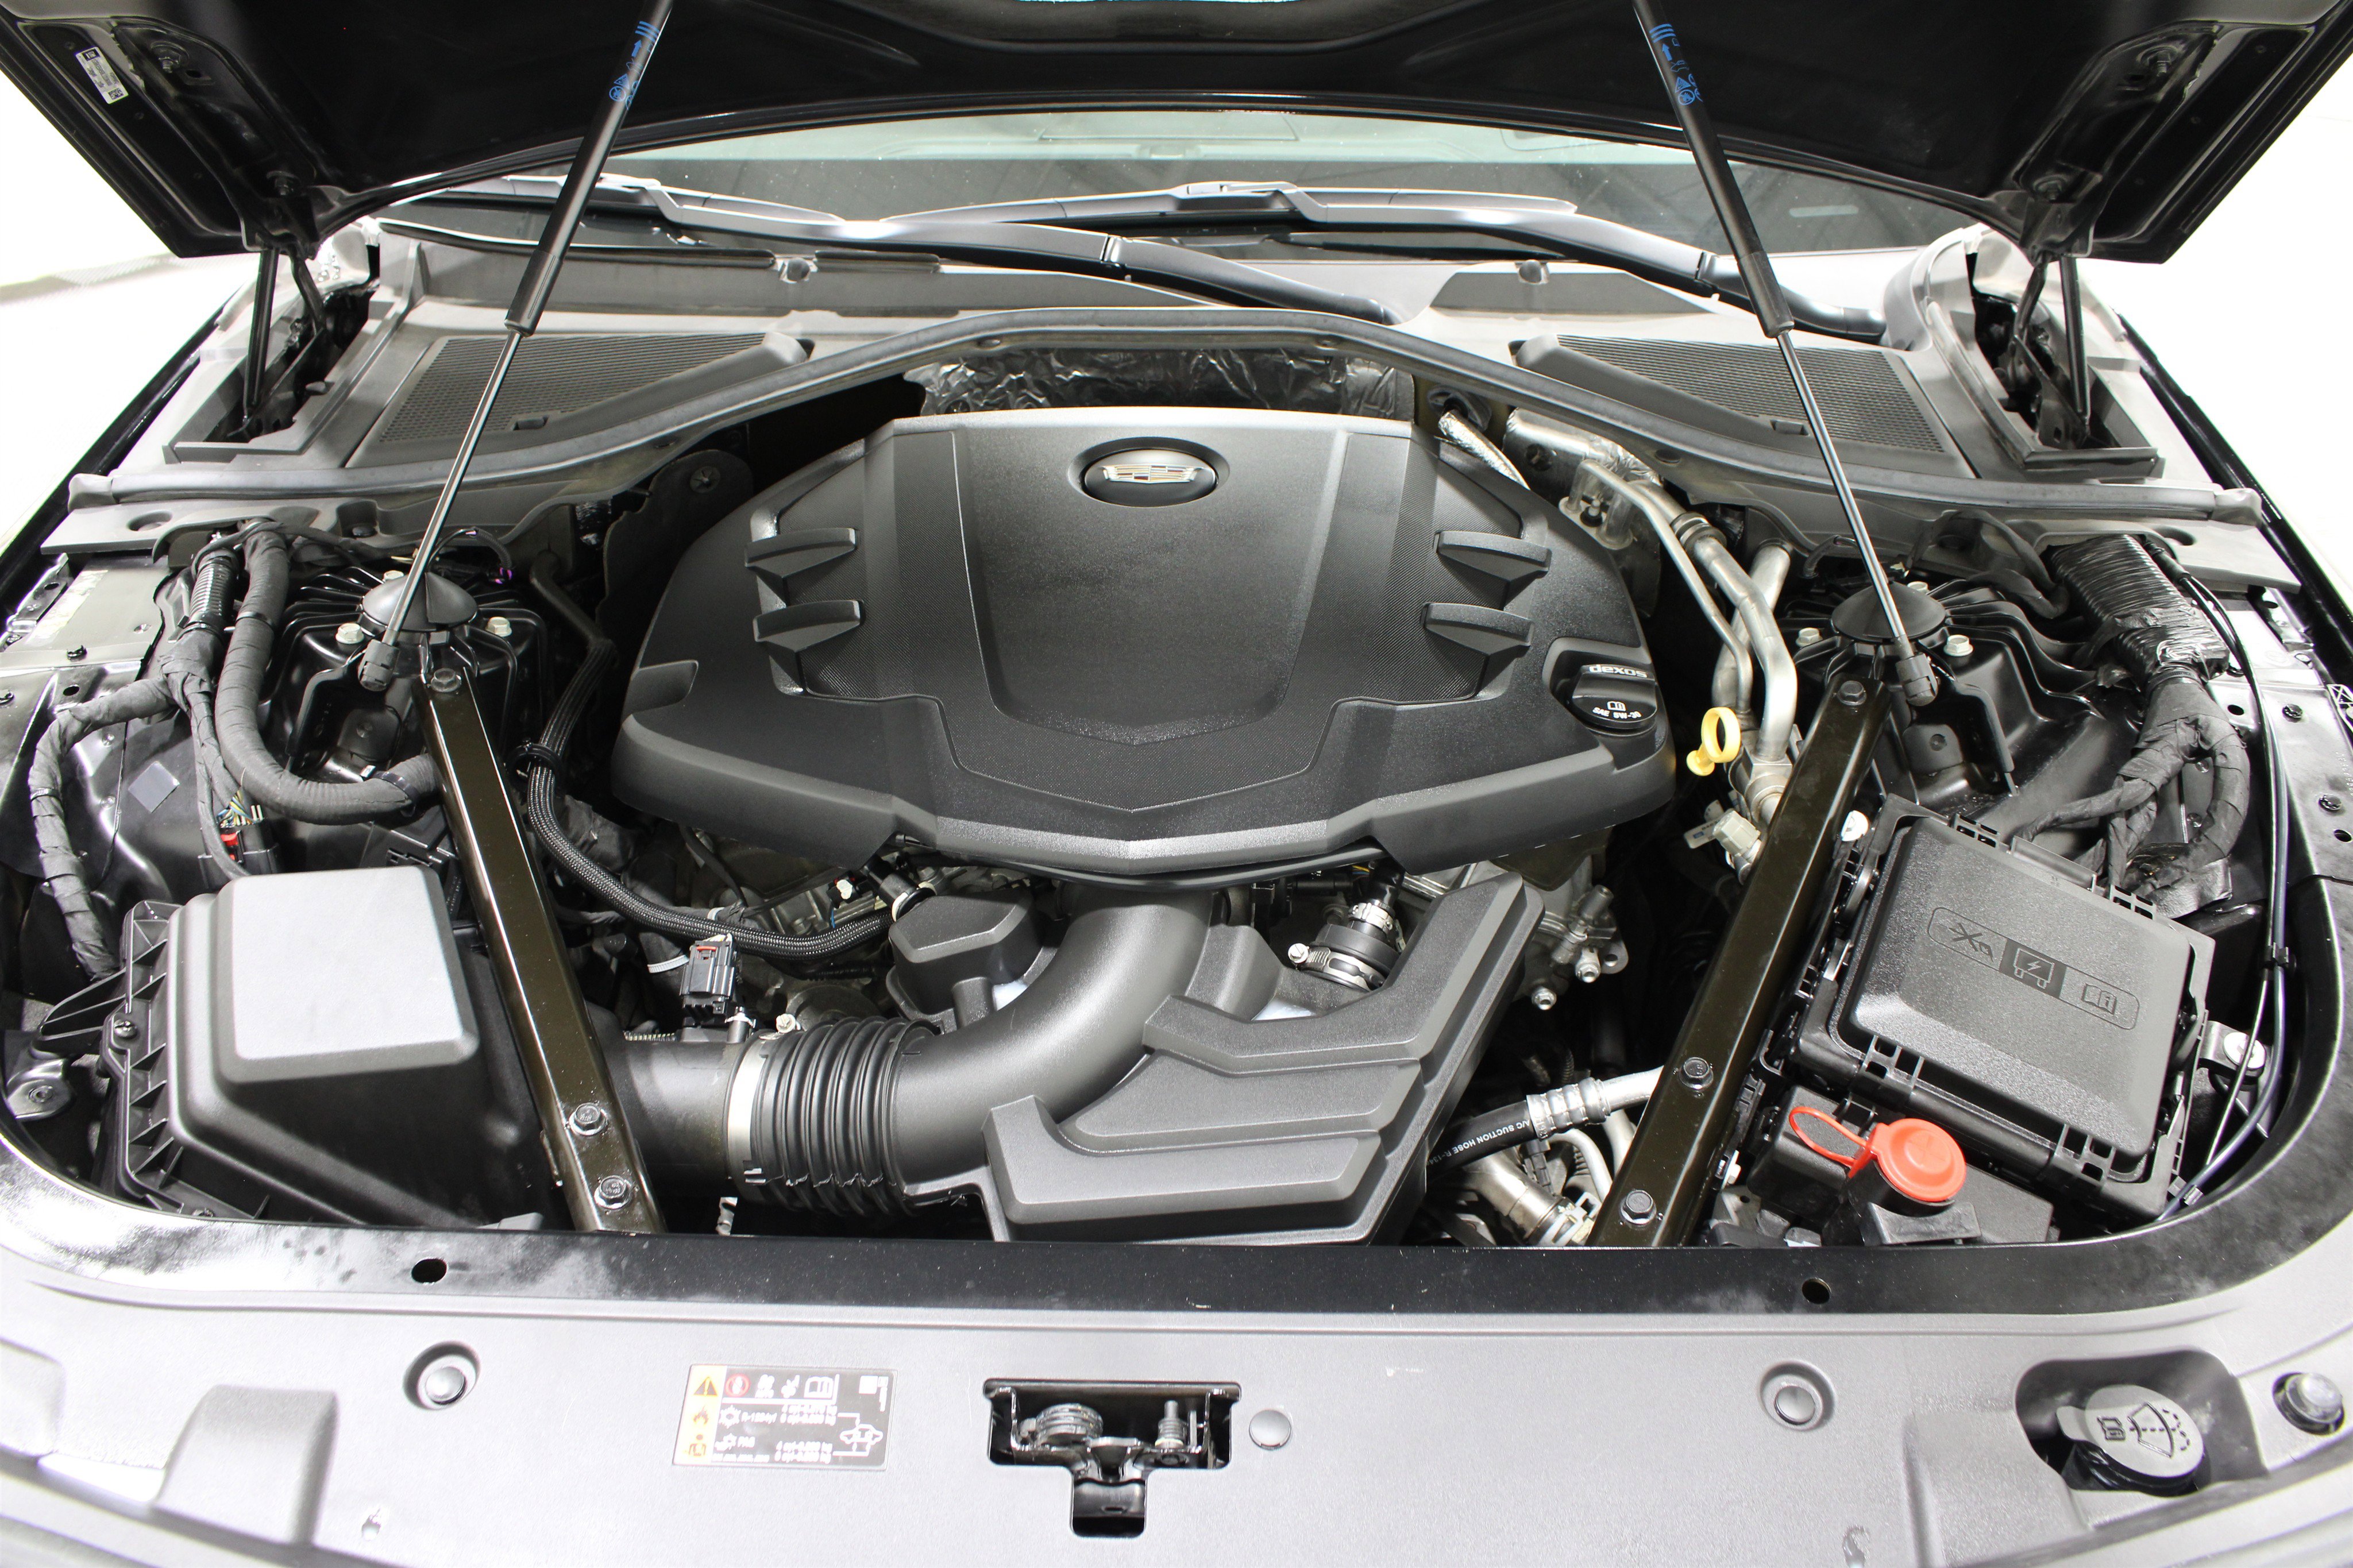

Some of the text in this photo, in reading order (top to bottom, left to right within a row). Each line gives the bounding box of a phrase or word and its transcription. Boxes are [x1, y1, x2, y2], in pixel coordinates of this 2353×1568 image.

[1589, 665, 1648, 678] dexos
[1592, 707, 1642, 719] SAE 5W-30
[1515, 1119, 1530, 1129] A/C
[1476, 1125, 1515, 1144] SUCTION
[1452, 1138, 1476, 1154] HOSE
